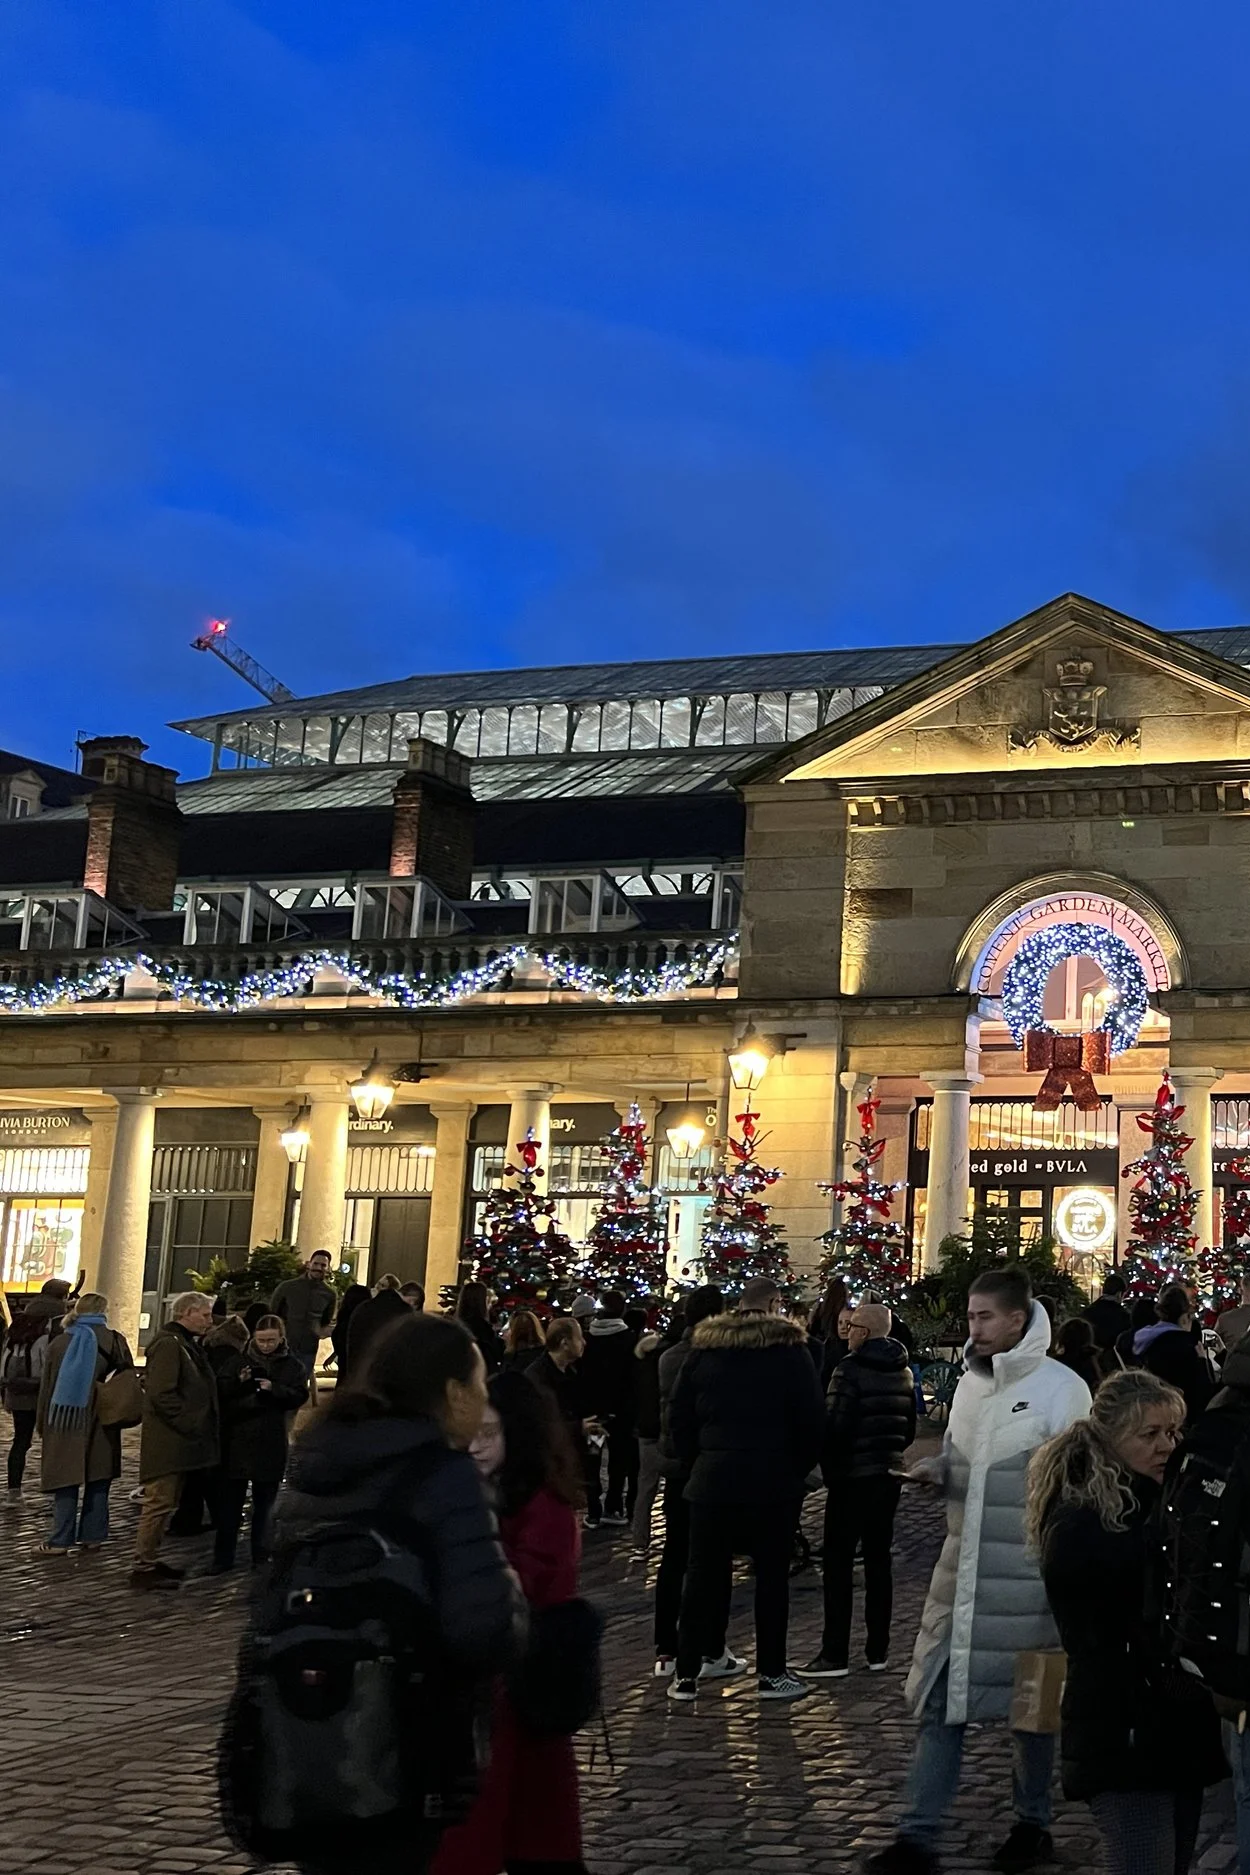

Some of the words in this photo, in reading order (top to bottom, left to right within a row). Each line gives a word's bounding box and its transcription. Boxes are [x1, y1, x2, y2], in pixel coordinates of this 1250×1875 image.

[978, 910, 1023, 992] COVENT
[1030, 897, 1117, 920] GARDEN
[1118, 910, 1169, 991] MARKET
[23, 1116, 70, 1128] BURTON
[970, 1160, 988, 1173] ed
[994, 1159, 1028, 1176] gold
[1046, 1160, 1087, 1173] BVLA
